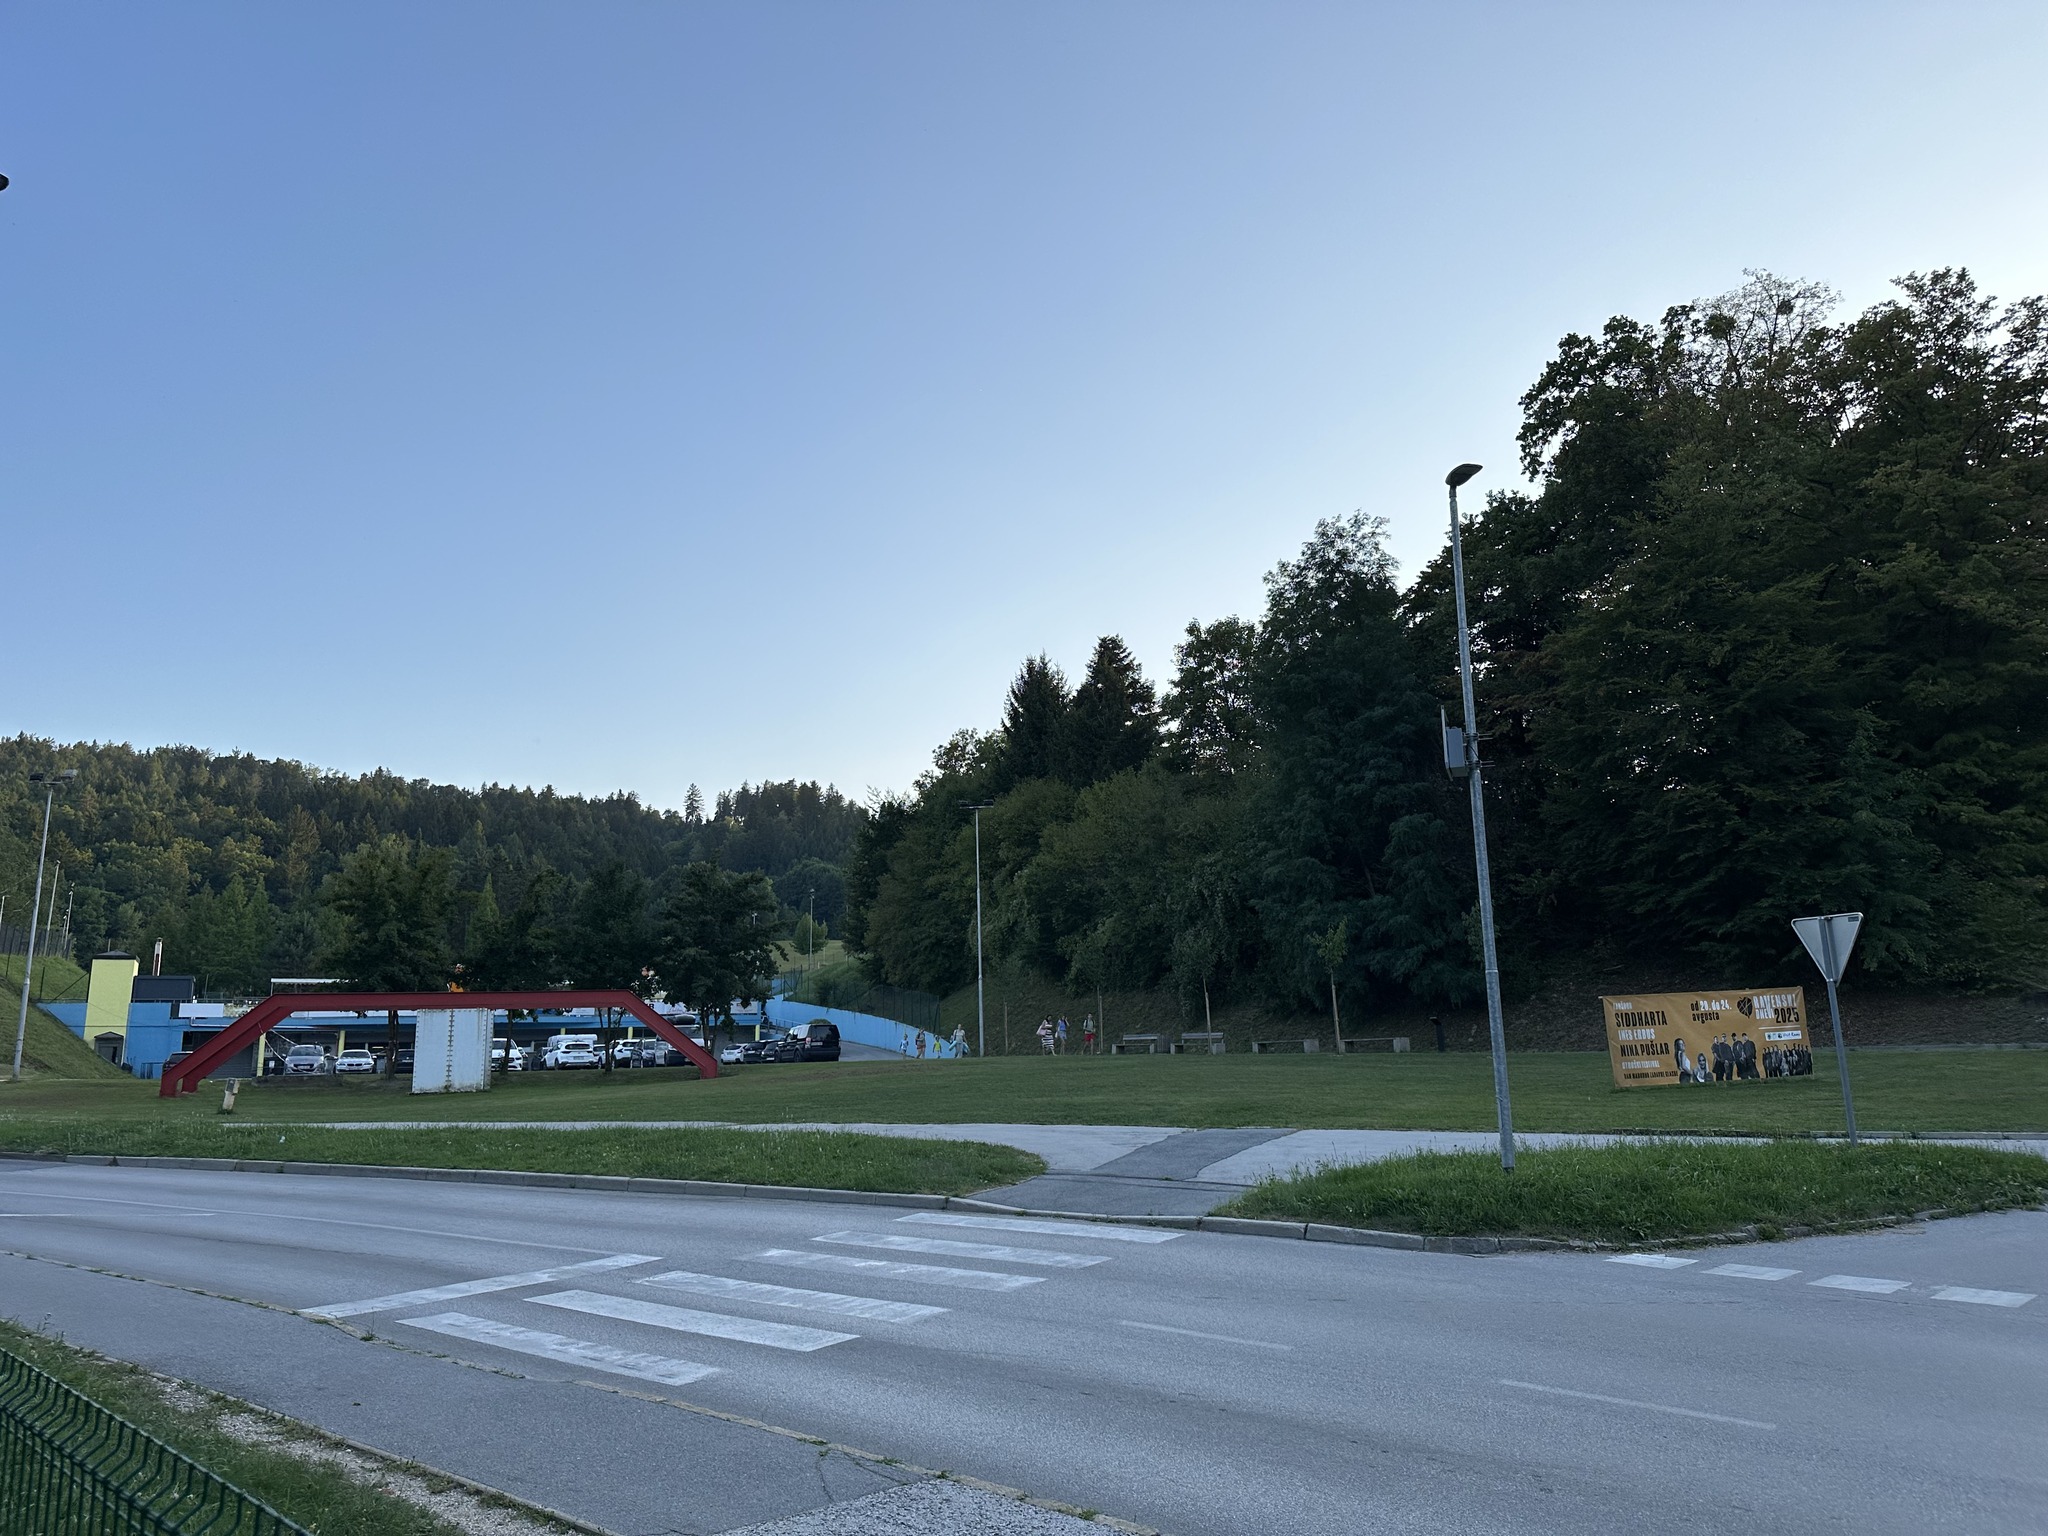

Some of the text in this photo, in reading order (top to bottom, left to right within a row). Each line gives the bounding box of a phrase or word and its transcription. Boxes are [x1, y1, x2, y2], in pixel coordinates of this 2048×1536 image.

[1691, 1001, 1699, 1011] od
[1712, 1000, 1720, 1011] do
[1753, 994, 1797, 1009] RAVENSKI
[1615, 1011, 1668, 1027] SIDDHARTA
[1692, 1012, 1720, 1024] avgusta
[1774, 1007, 1799, 1024] 2025
[1620, 1040, 1670, 1057] NINA PUŠLAR
